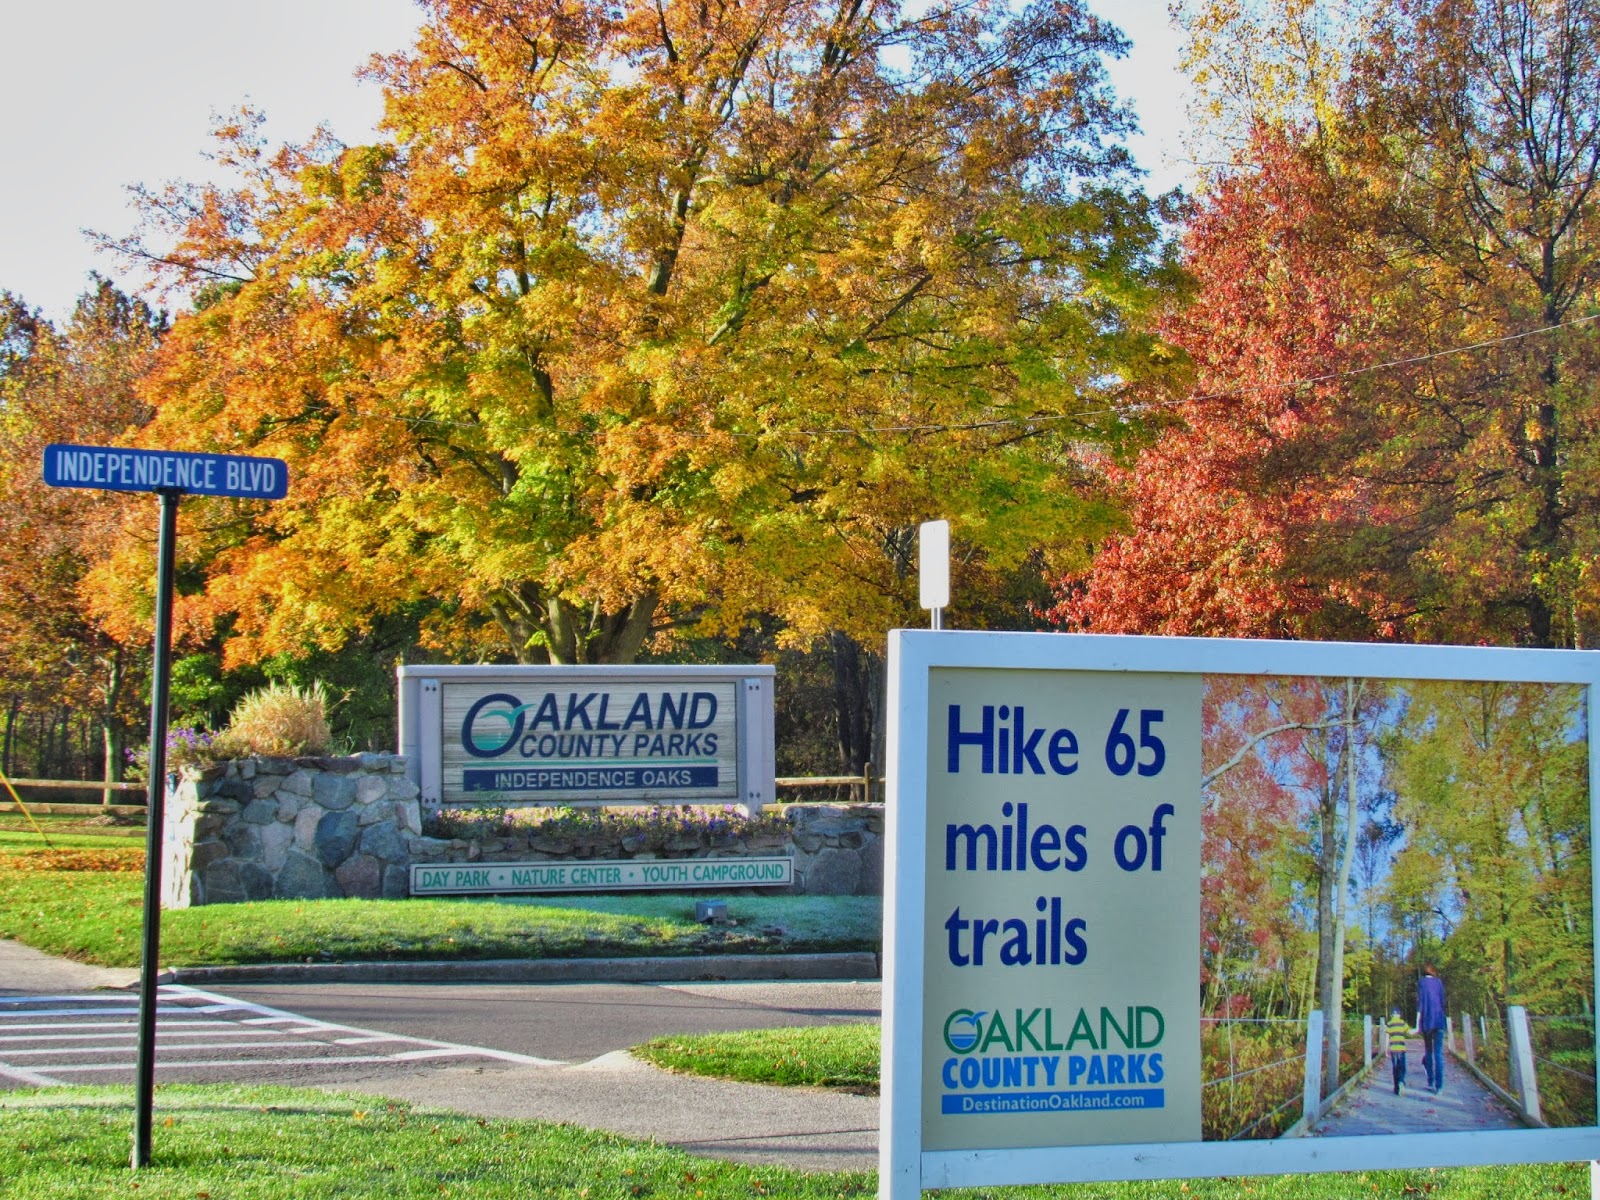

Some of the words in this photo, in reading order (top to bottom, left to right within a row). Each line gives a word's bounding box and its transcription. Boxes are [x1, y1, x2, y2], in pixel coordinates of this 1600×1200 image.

[57, 451, 216, 489] INDEPENDENCE
[226, 461, 276, 492] BLVD
[461, 692, 718, 758] OAKLAND
[519, 733, 626, 758] COUNTY
[633, 733, 718, 757] PARKS
[947, 704, 1079, 775] Hike
[1105, 708, 1166, 777] 65
[495, 770, 635, 788] INDEPENDENCE
[642, 770, 692, 787] OAKS
[946, 801, 1088, 872] miles
[1114, 803, 1174, 872] of
[422, 870, 450, 887] DAY
[455, 870, 490, 886] PARK
[511, 867, 567, 885] NATURE
[570, 866, 621, 884] CENTER
[642, 864, 688, 882] YOUTH
[692, 863, 784, 881] CAMPGROUND
[945, 896, 1088, 967] trails
[943, 1006, 1165, 1055] OAKLAND
[942, 1055, 1060, 1089] COUNTY
[1068, 1053, 1164, 1086] PARKS
[962, 1094, 1145, 1112] DestinationOakland.com
